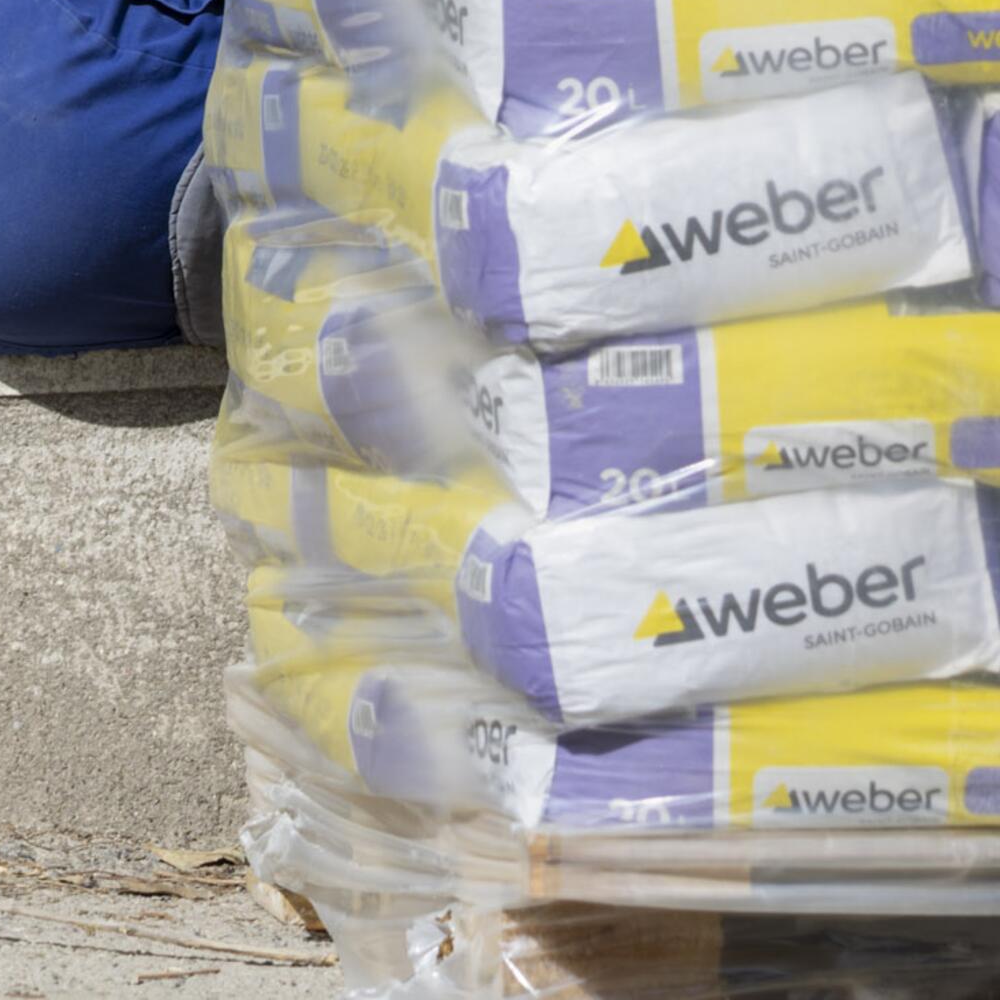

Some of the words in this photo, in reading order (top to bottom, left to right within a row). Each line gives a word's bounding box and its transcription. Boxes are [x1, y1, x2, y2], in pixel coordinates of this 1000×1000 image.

[749, 36, 887, 75] weber
[556, 76, 621, 117] 20
[661, 165, 884, 262] weber
[768, 222, 899, 268] SAINT-GOBAIN
[792, 434, 928, 469] weber
[697, 555, 925, 637] weber
[803, 611, 937, 650] SAINT-GOBAIN
[803, 780, 942, 814] weber
